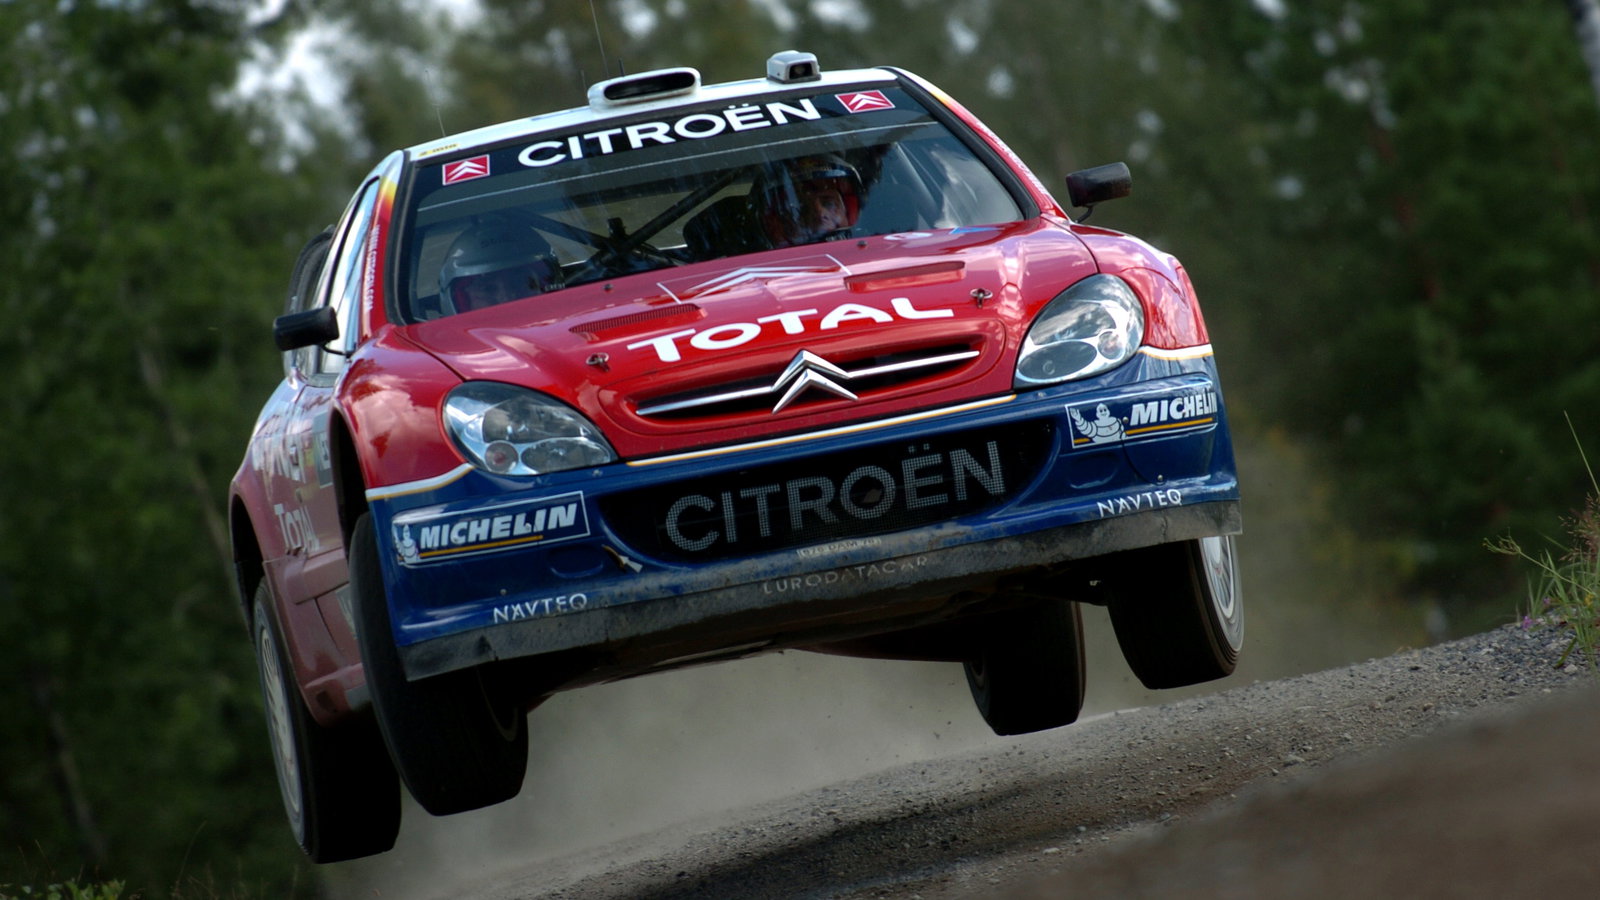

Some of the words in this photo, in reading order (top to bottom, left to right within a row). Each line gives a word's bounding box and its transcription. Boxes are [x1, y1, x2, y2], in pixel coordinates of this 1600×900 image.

[518, 98, 822, 168] CITROËN
[626, 296, 955, 363] TOTAL
[1129, 391, 1218, 426] MICHELIN
[665, 440, 1006, 552] CITROËN
[1096, 488, 1183, 518] NAVTEQ
[420, 502, 578, 550] MICHELIN
[492, 592, 588, 624] NAVTEQ
